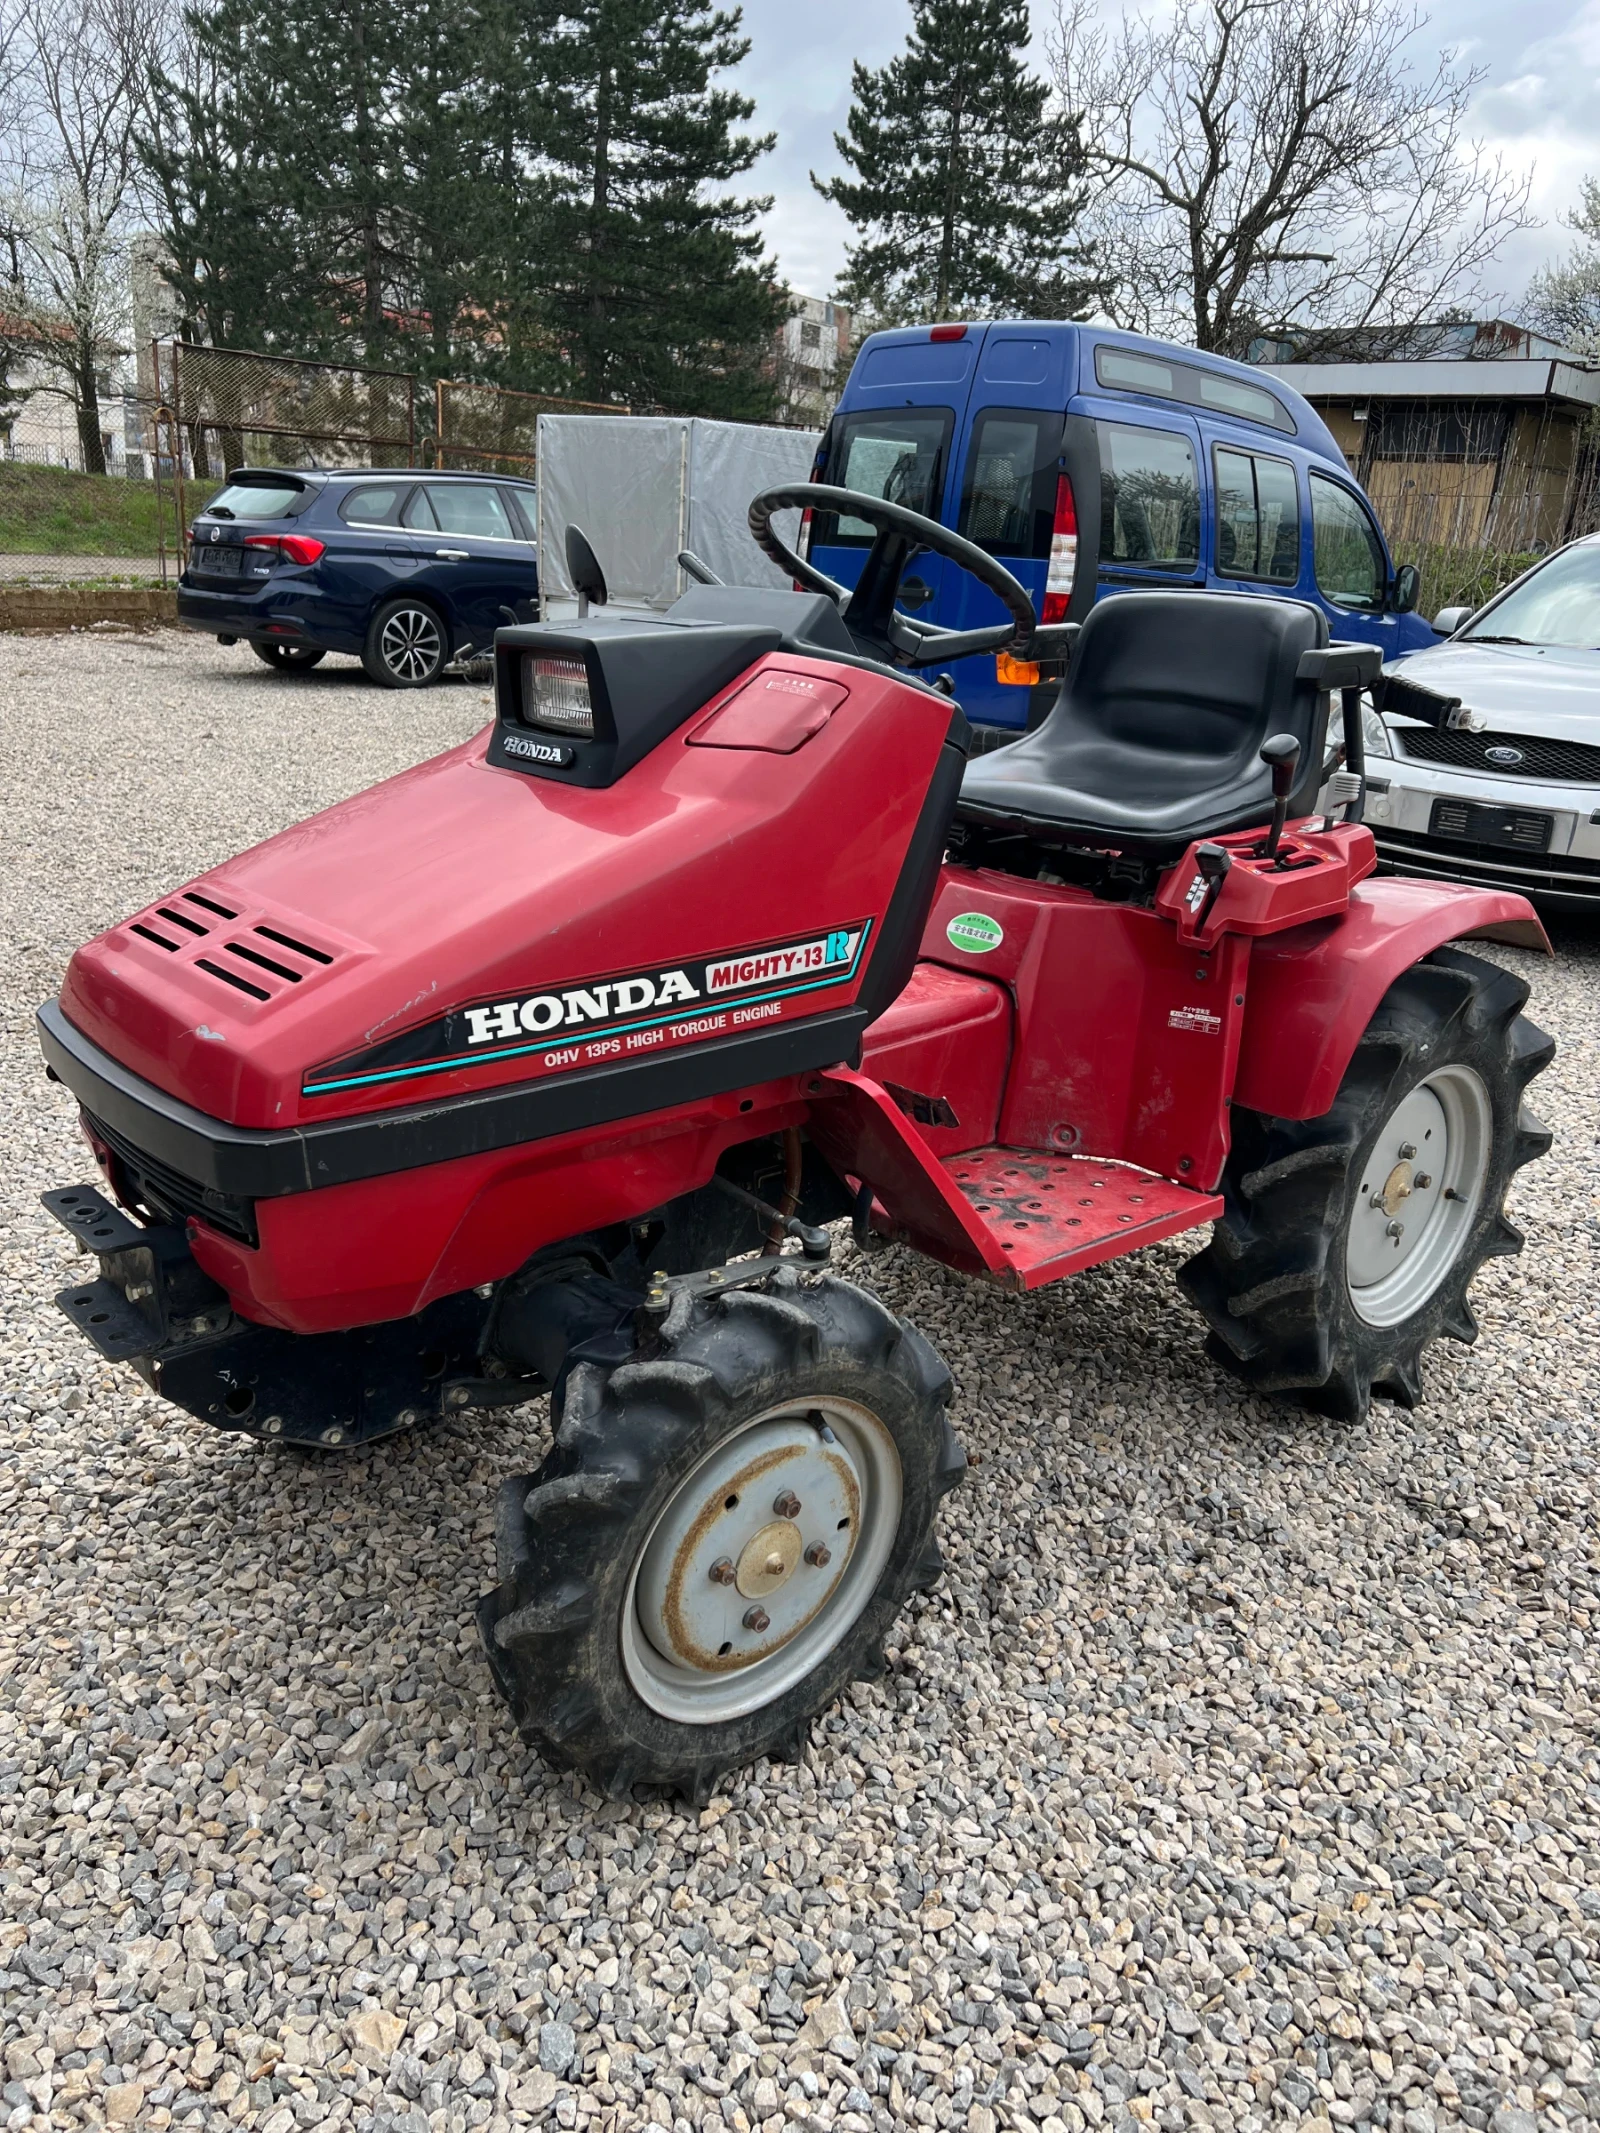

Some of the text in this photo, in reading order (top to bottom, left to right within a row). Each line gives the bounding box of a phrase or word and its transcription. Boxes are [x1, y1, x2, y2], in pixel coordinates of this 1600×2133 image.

[504, 736, 562, 762] HONDA
[463, 970, 700, 1044] HONDA
[544, 1002, 782, 1067] OHV 13PS HIGH TORQUE ENGINE
